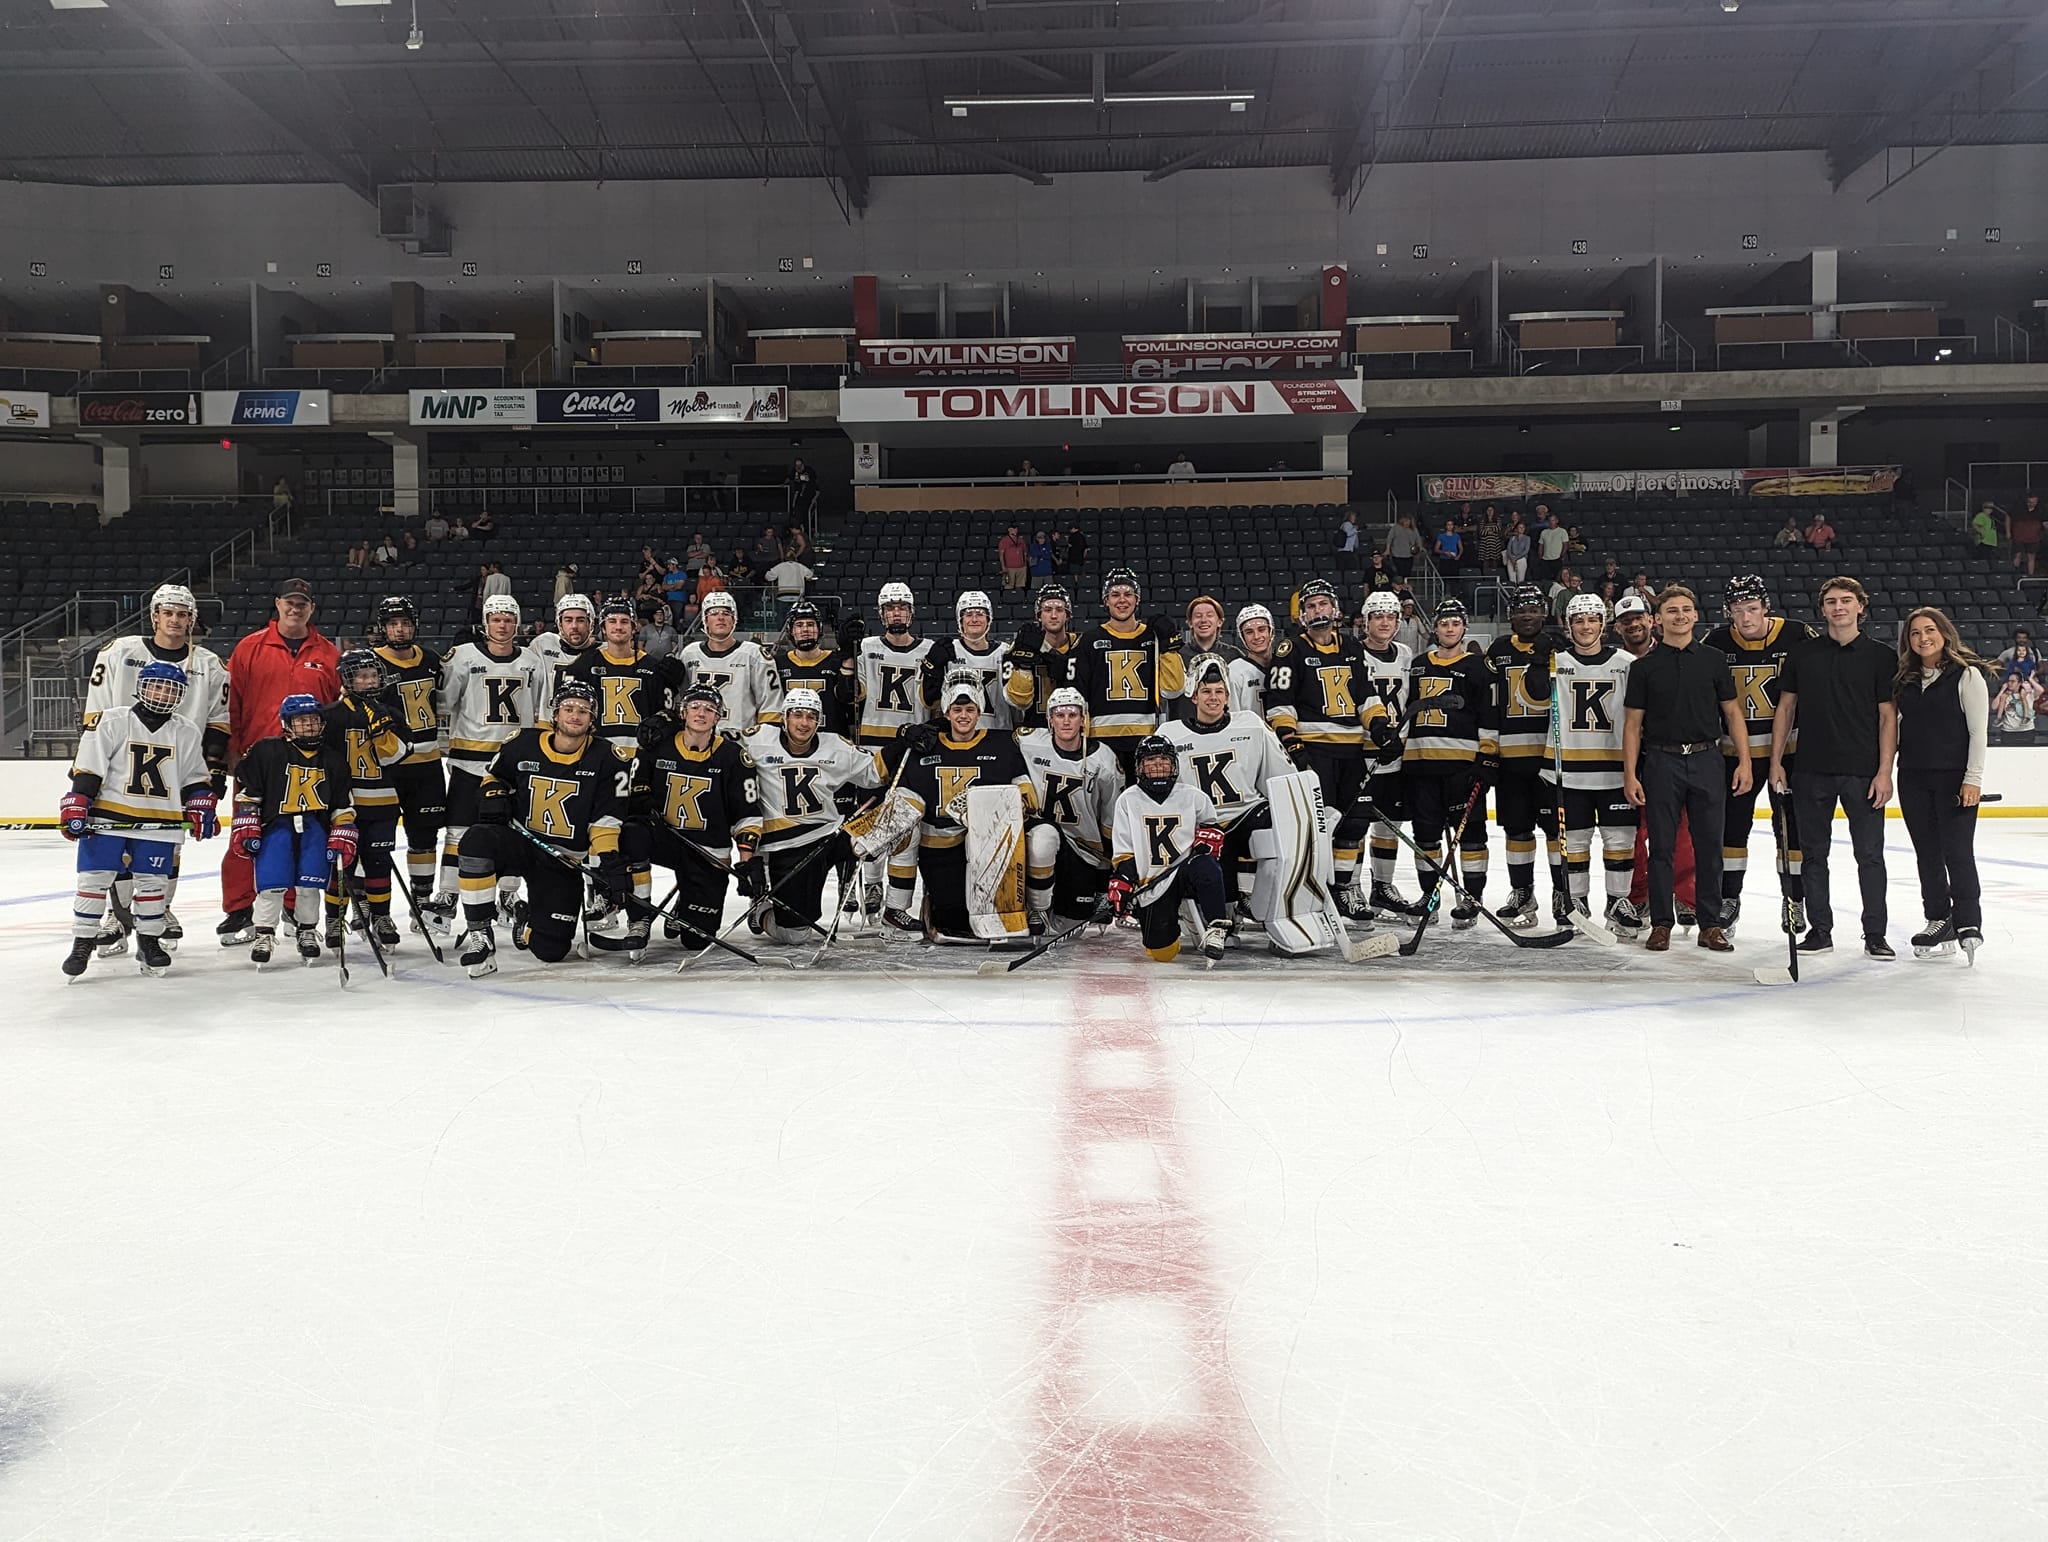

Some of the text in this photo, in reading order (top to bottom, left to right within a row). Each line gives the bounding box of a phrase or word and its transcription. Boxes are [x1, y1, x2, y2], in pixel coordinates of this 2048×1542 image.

[1572, 241, 1587, 253] 438
[1743, 236, 1757, 247] 439
[1985, 230, 2000, 241] 440
[1413, 246, 1428, 258] 437
[30, 264, 46, 275] 430
[160, 266, 174, 278] 431
[316, 265, 331, 276] 432
[462, 264, 477, 275] 433
[627, 262, 641, 273] 434
[779, 259, 793, 271] 435
[866, 344, 1069, 366] TOMLINSON
[1125, 338, 1339, 352] TOMLINSONGROUP.COM
[243, 406, 288, 419] KPMG
[420, 395, 488, 419] MNP
[667, 398, 717, 418] Molson
[904, 384, 1255, 418] TOMLINSON
[145, 407, 185, 421] zero
[1572, 474, 1741, 492] www.OrderGinos.ca
[90, 663, 106, 687] 3
[766, 669, 780, 691] 2
[1002, 660, 1015, 680] 3
[1066, 657, 1077, 681] 5
[1105, 650, 1149, 701] K
[1269, 665, 1293, 690] 28
[220, 683, 230, 706] 9
[663, 687, 674, 710] 3
[876, 663, 918, 714] K
[1315, 665, 1356, 718] K
[1489, 682, 1499, 707] 1
[1729, 664, 1778, 721] K
[397, 677, 438, 733] K
[481, 676, 524, 726] K
[601, 676, 642, 727] K
[1373, 675, 1403, 729] K
[1415, 677, 1454, 728] K
[1569, 679, 1617, 733] K
[345, 728, 382, 780] K
[124, 740, 175, 801] K
[575, 770, 596, 778] CCM
[1189, 748, 1244, 809] K
[279, 763, 329, 815] K
[614, 770, 632, 798] 2
[744, 777, 760, 804] 8
[778, 764, 825, 818] K
[935, 766, 981, 818] K
[525, 774, 580, 840] K
[662, 772, 713, 831] K
[1040, 770, 1085, 826] K
[1312, 786, 1327, 834] VAUGHN
[84, 822, 113, 830] ACKS
[1196, 829, 1222, 841] CCM
[1558, 806, 1568, 858] CCM
[1142, 814, 1183, 869] K
[300, 875, 326, 884] CCM
[688, 903, 719, 915] CCM
